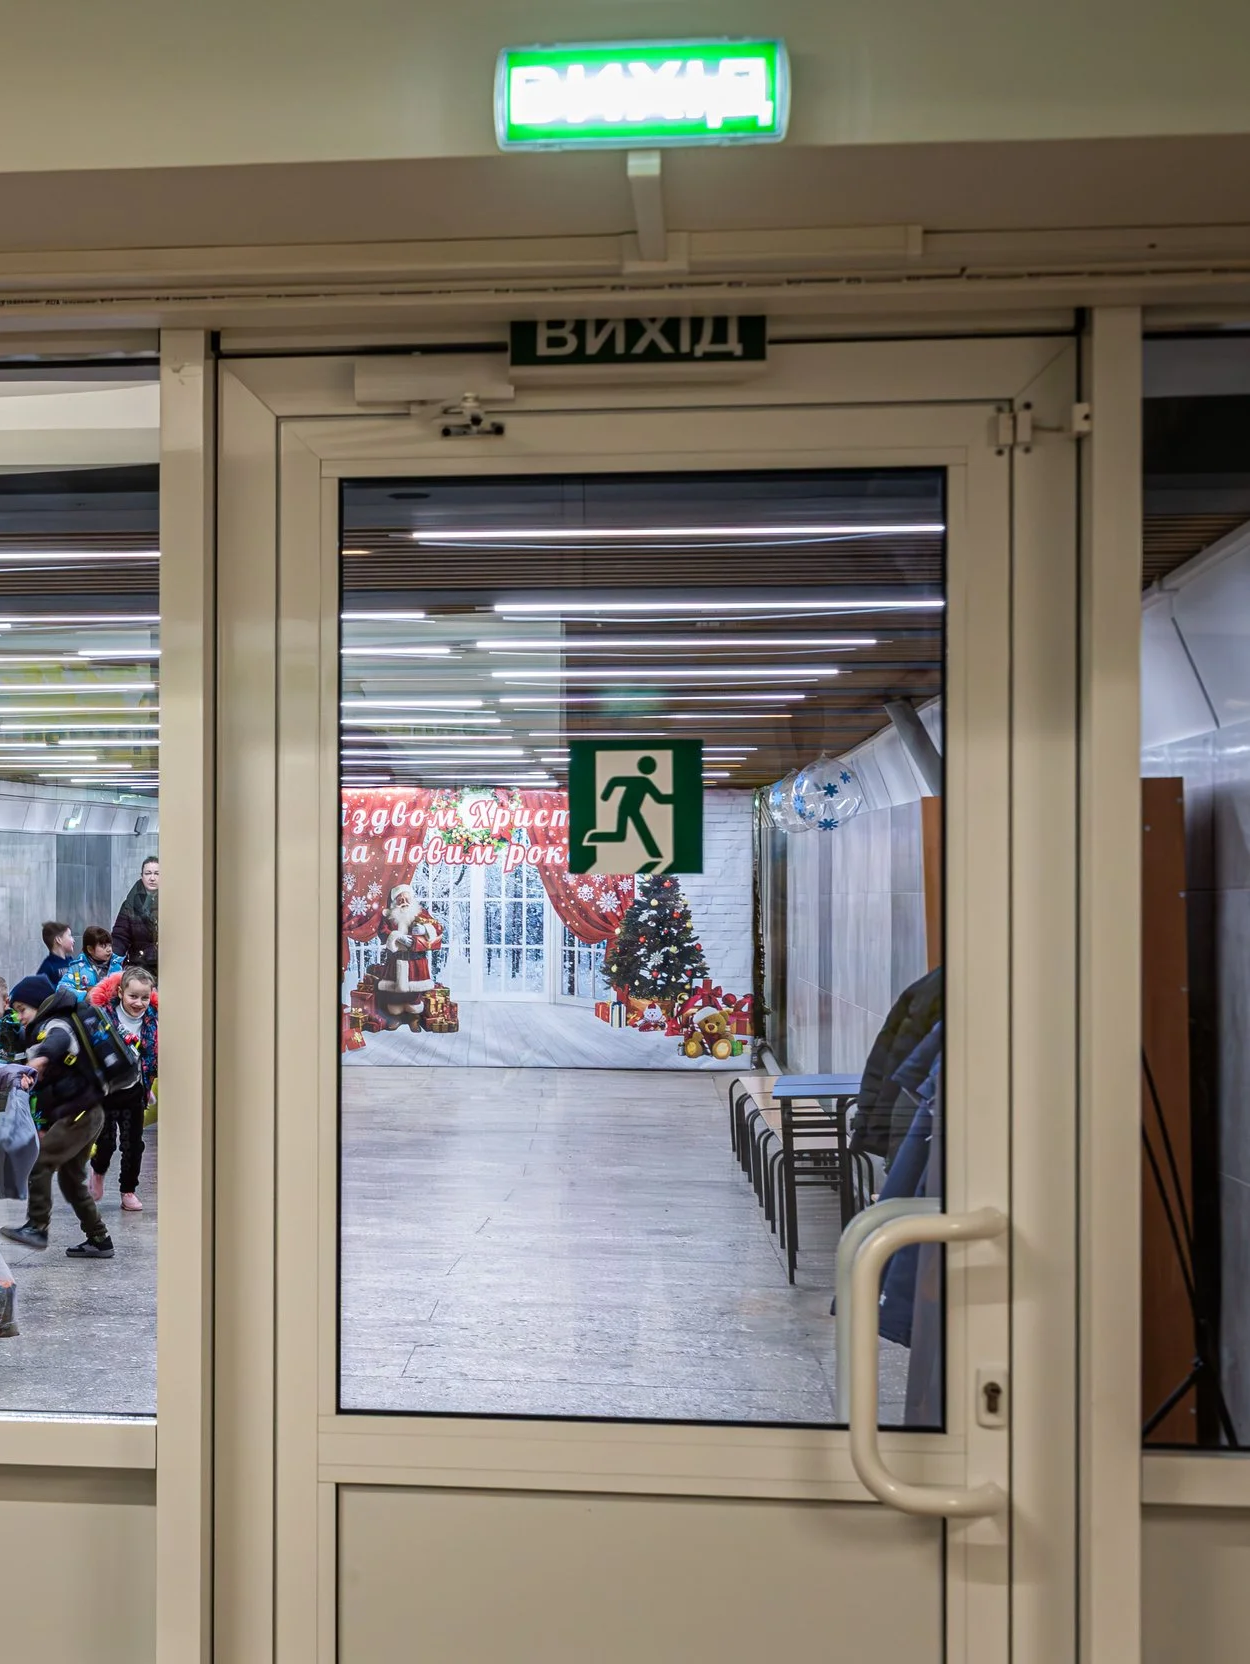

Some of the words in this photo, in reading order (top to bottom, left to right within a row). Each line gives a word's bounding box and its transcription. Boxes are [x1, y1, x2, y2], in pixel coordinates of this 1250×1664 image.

[510, 57, 773, 128] ВИХІД
[536, 315, 743, 357] ВИХІД
[383, 836, 497, 864] Новим
[505, 844, 569, 872] рок
